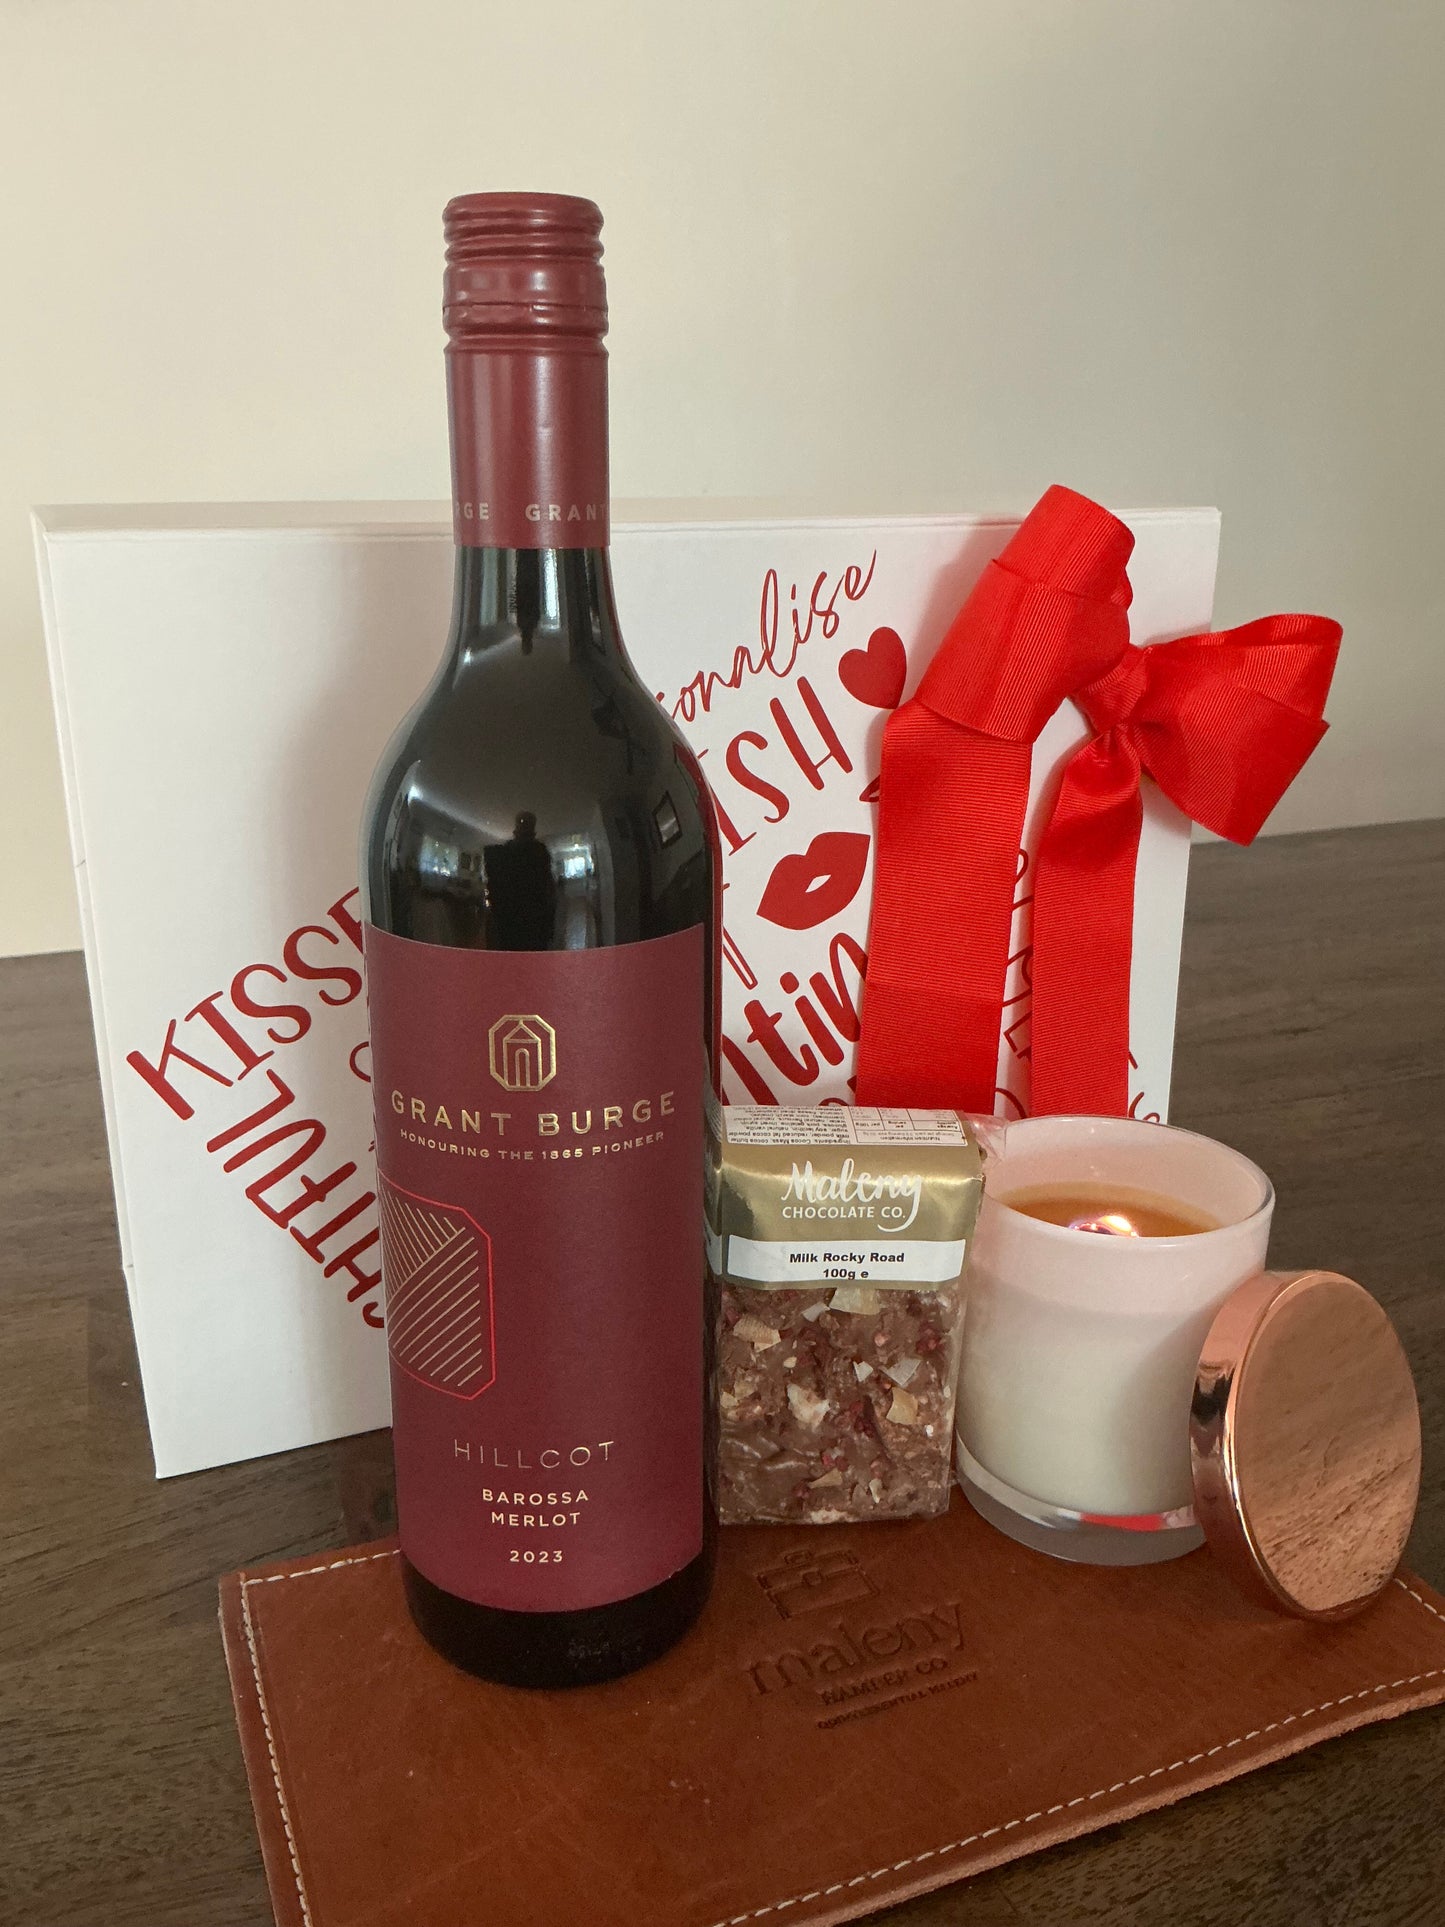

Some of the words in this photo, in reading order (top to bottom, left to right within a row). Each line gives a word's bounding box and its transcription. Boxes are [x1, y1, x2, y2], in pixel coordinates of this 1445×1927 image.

[656, 548, 877, 723] onalise
[391, 1089, 512, 1136] GRANT
[537, 1091, 675, 1137] BURGE
[399, 1128, 490, 1159] HONOURING
[497, 1150, 534, 1161] THE
[541, 1148, 584, 1161] 1865
[591, 1131, 665, 1157] PIONEER
[207, 1068, 385, 1329] HTFUL
[780, 1157, 922, 1233] Maleny
[782, 1206, 875, 1219] CHOCOLATE
[881, 1206, 906, 1219] CO.
[789, 1253, 818, 1264] Milk
[823, 1253, 865, 1264] Rocky
[869, 1252, 905, 1263] Road
[822, 1268, 856, 1281] 100g
[453, 1438, 615, 1469] HILLCOT
[482, 1488, 589, 1506] BAROSSA
[491, 1511, 581, 1528] MERLOT
[509, 1550, 564, 1564] 2023
[748, 1602, 965, 1696] maleny
[915, 1656, 949, 1675] CO
